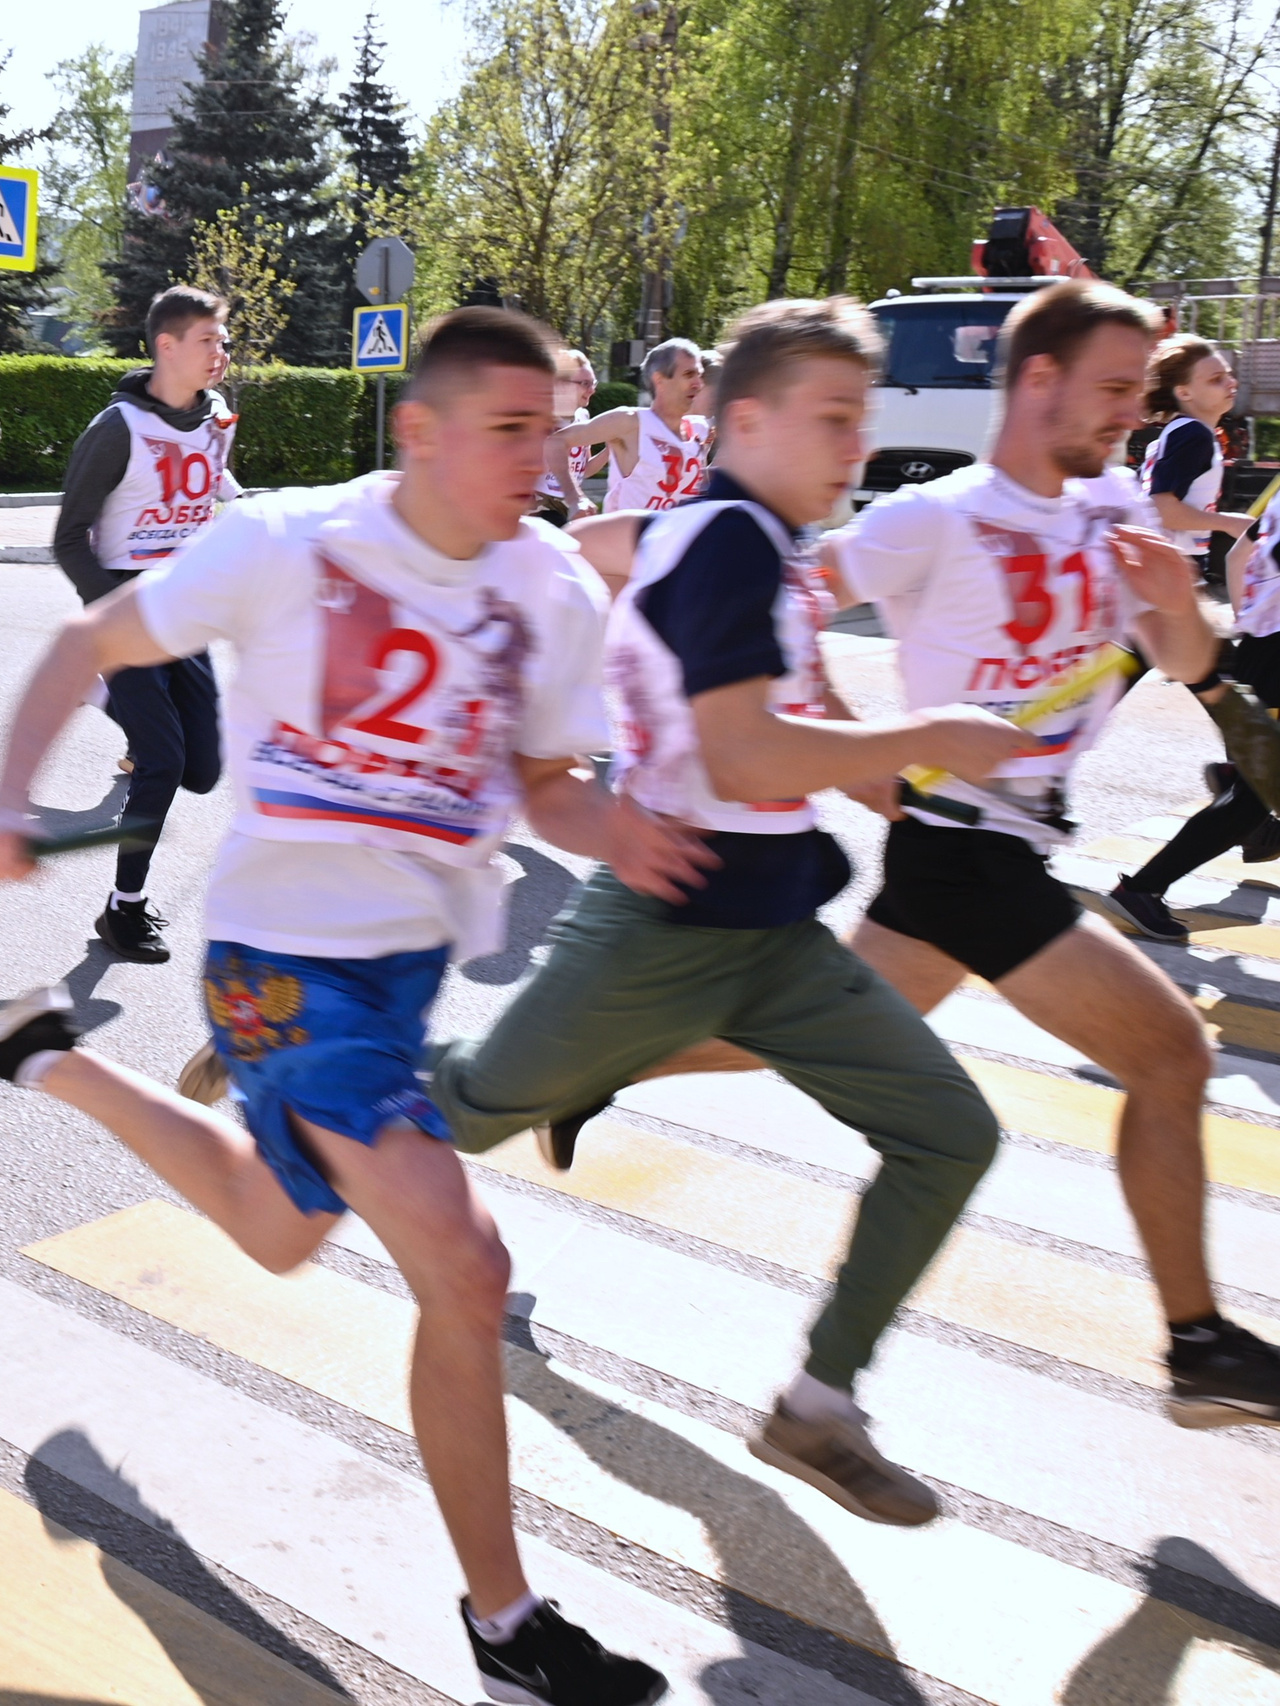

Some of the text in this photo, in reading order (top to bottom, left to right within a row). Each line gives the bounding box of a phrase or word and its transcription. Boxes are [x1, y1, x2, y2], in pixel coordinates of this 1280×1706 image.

[155, 452, 211, 502] 10
[657, 454, 701, 496] 32
[999, 551, 1091, 645] 31
